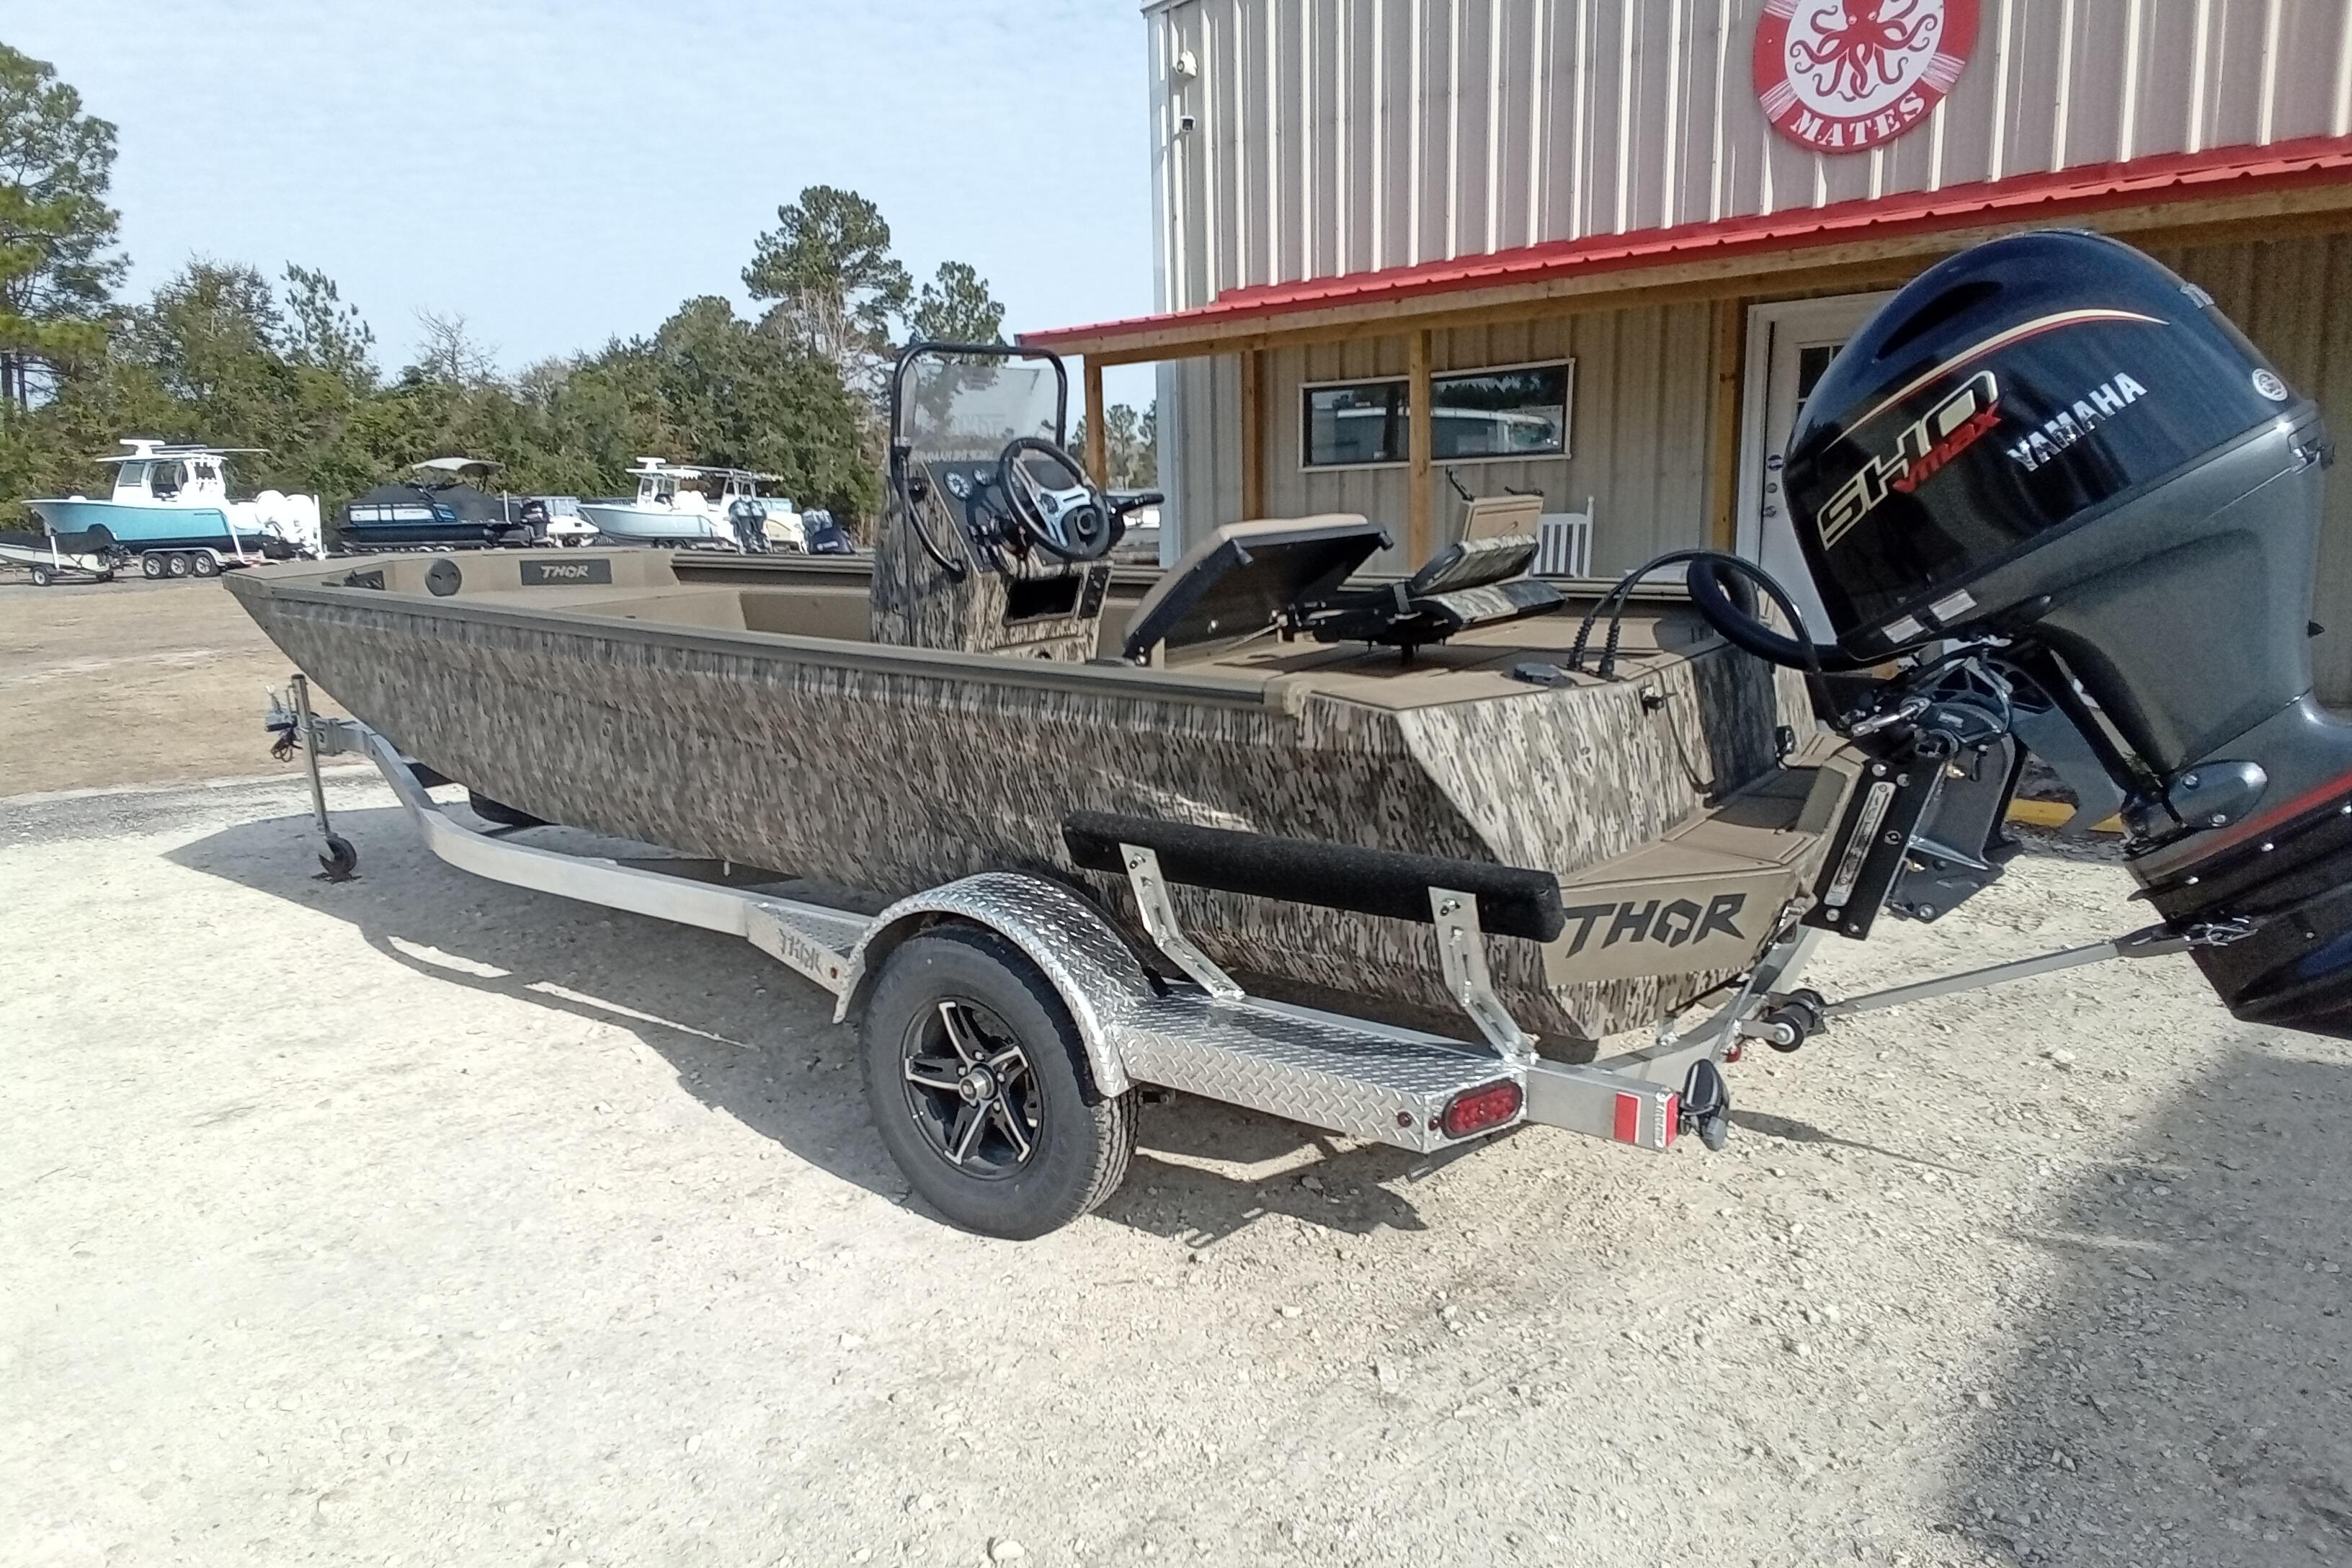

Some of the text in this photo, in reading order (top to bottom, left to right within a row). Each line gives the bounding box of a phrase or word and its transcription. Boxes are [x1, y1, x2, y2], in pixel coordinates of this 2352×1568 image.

[1789, 92, 1925, 147] MATES
[2006, 372, 2148, 472] YAMAHA
[1817, 370, 1998, 551] SHO
[540, 565, 589, 579] THOR
[1562, 893, 1747, 958] THOR
